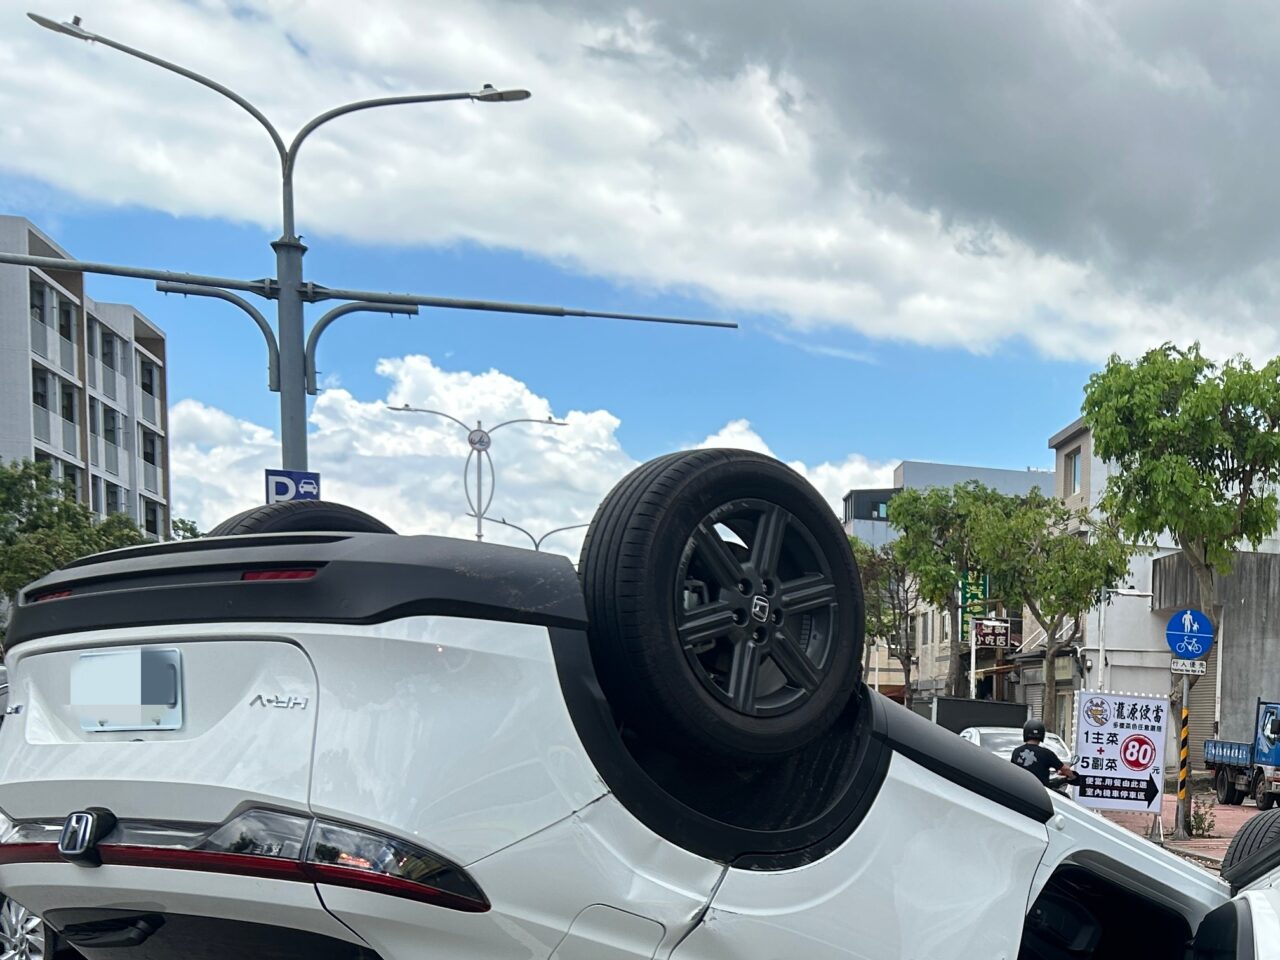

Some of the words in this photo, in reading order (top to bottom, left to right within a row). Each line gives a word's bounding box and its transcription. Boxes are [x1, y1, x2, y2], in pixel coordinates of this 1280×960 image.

[268, 475, 297, 505] P
[1113, 701, 1164, 724] 瀧源便當
[1083, 730, 1120, 746] 1主菜
[1125, 741, 1152, 765] 80
[1080, 756, 1118, 772] 5副菜
[1152, 765, 1161, 775] 元
[1085, 787, 1146, 800] 室內機車停車區
